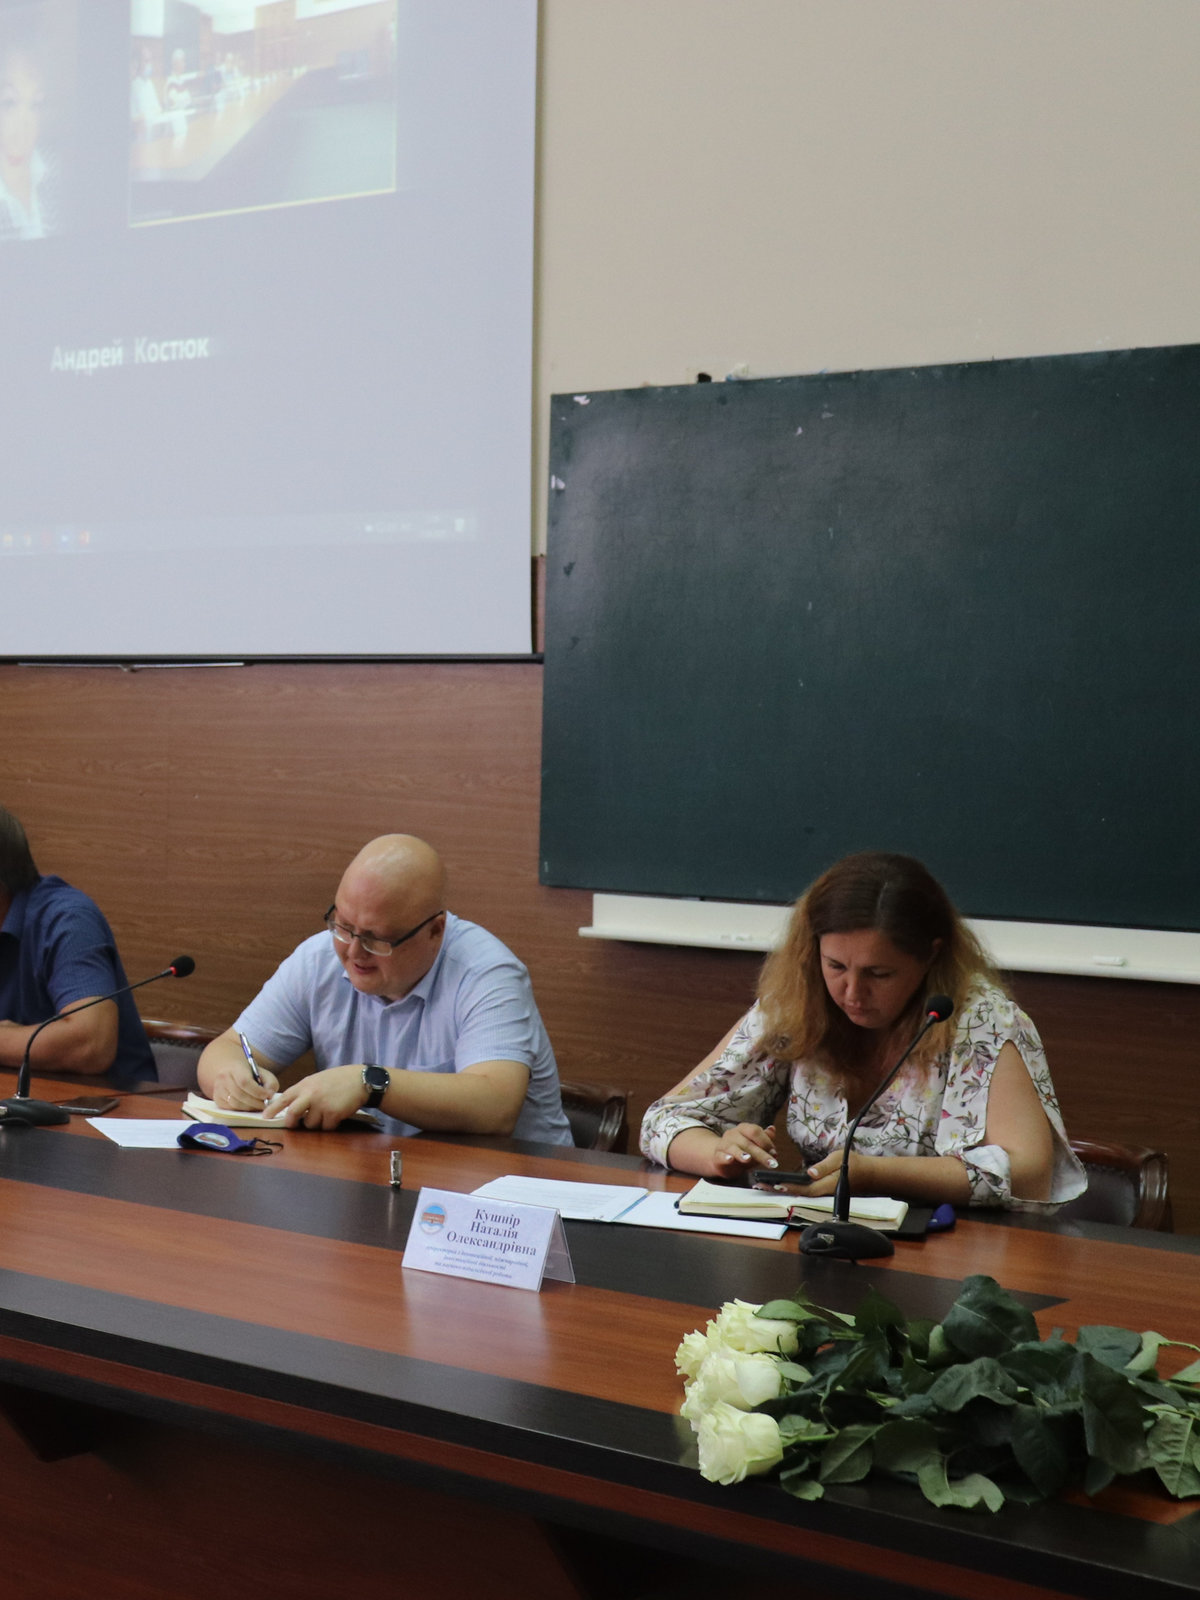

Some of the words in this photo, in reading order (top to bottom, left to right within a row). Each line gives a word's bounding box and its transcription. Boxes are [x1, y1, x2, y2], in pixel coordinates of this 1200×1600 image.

[50, 338, 123, 376] Андрей
[135, 336, 209, 364] Костюк
[475, 1208, 520, 1227] Кушнір
[470, 1221, 518, 1239] Наталія
[446, 1231, 537, 1256] Олександрівна
